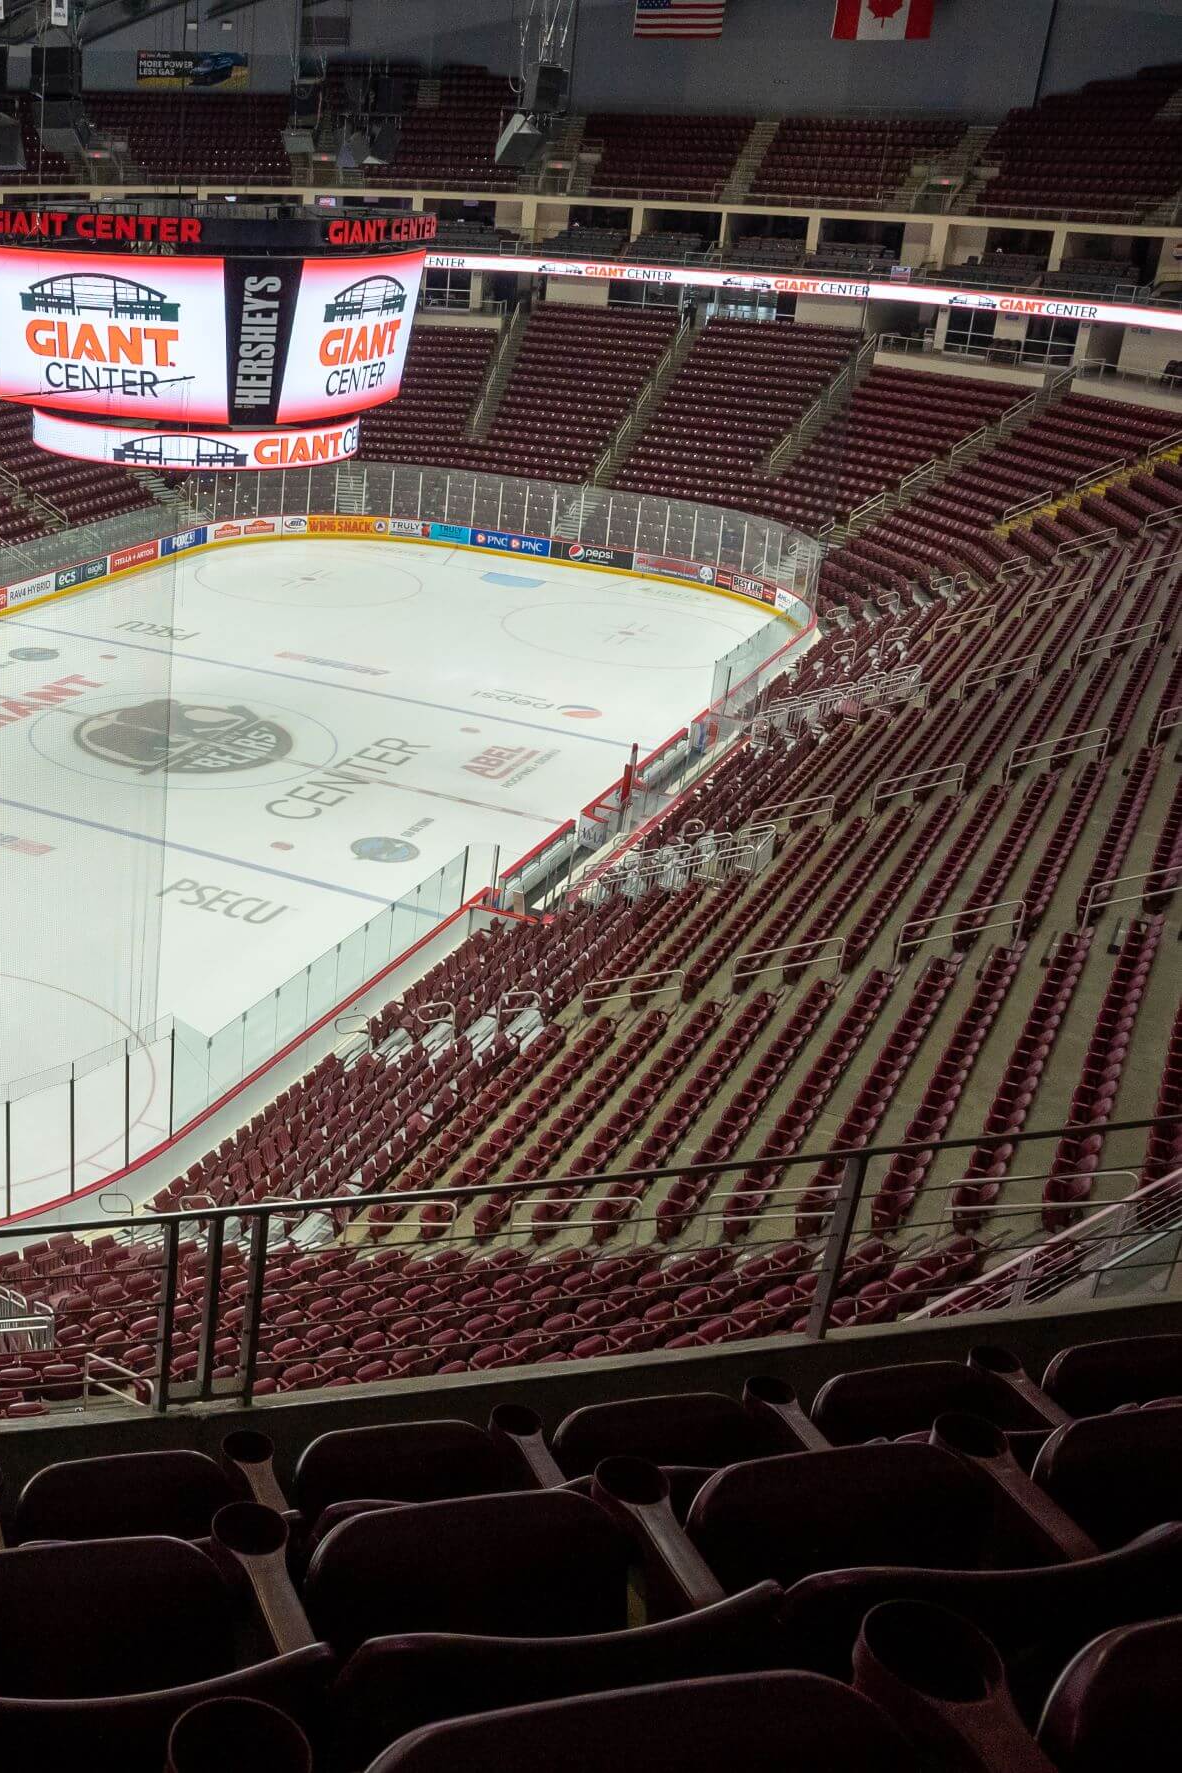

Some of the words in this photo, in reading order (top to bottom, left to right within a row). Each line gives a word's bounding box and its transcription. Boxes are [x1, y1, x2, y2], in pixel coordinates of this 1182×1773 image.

[139, 60, 163, 68] MORE
[75, 214, 203, 243] CENTER
[328, 218, 388, 245] GIANT
[391, 215, 437, 241] CENTER
[585, 265, 626, 279] GIANT
[626, 267, 672, 281] CENTER
[774, 278, 820, 293] GIANT
[820, 282, 871, 297] CENTER
[999, 298, 1046, 314] GIANT
[1046, 302, 1098, 319] CENTER
[234, 275, 282, 406] HERSHEY'S
[45, 361, 159, 398] CENTER
[325, 361, 386, 397] CENTER
[392, 521, 420, 531] TRULY
[439, 524, 463, 536] TRULY
[487, 535, 508, 547] PNC
[521, 540, 543, 553] PNC
[585, 547, 614, 562] pepsi
[58, 571, 76, 586] ecs
[733, 576, 750, 589] BEST
[9, 587, 27, 601] RAV4
[26, 580, 51, 596] HYBRID
[265, 737, 432, 820] CENTER
[156, 877, 289, 925] PSECU
